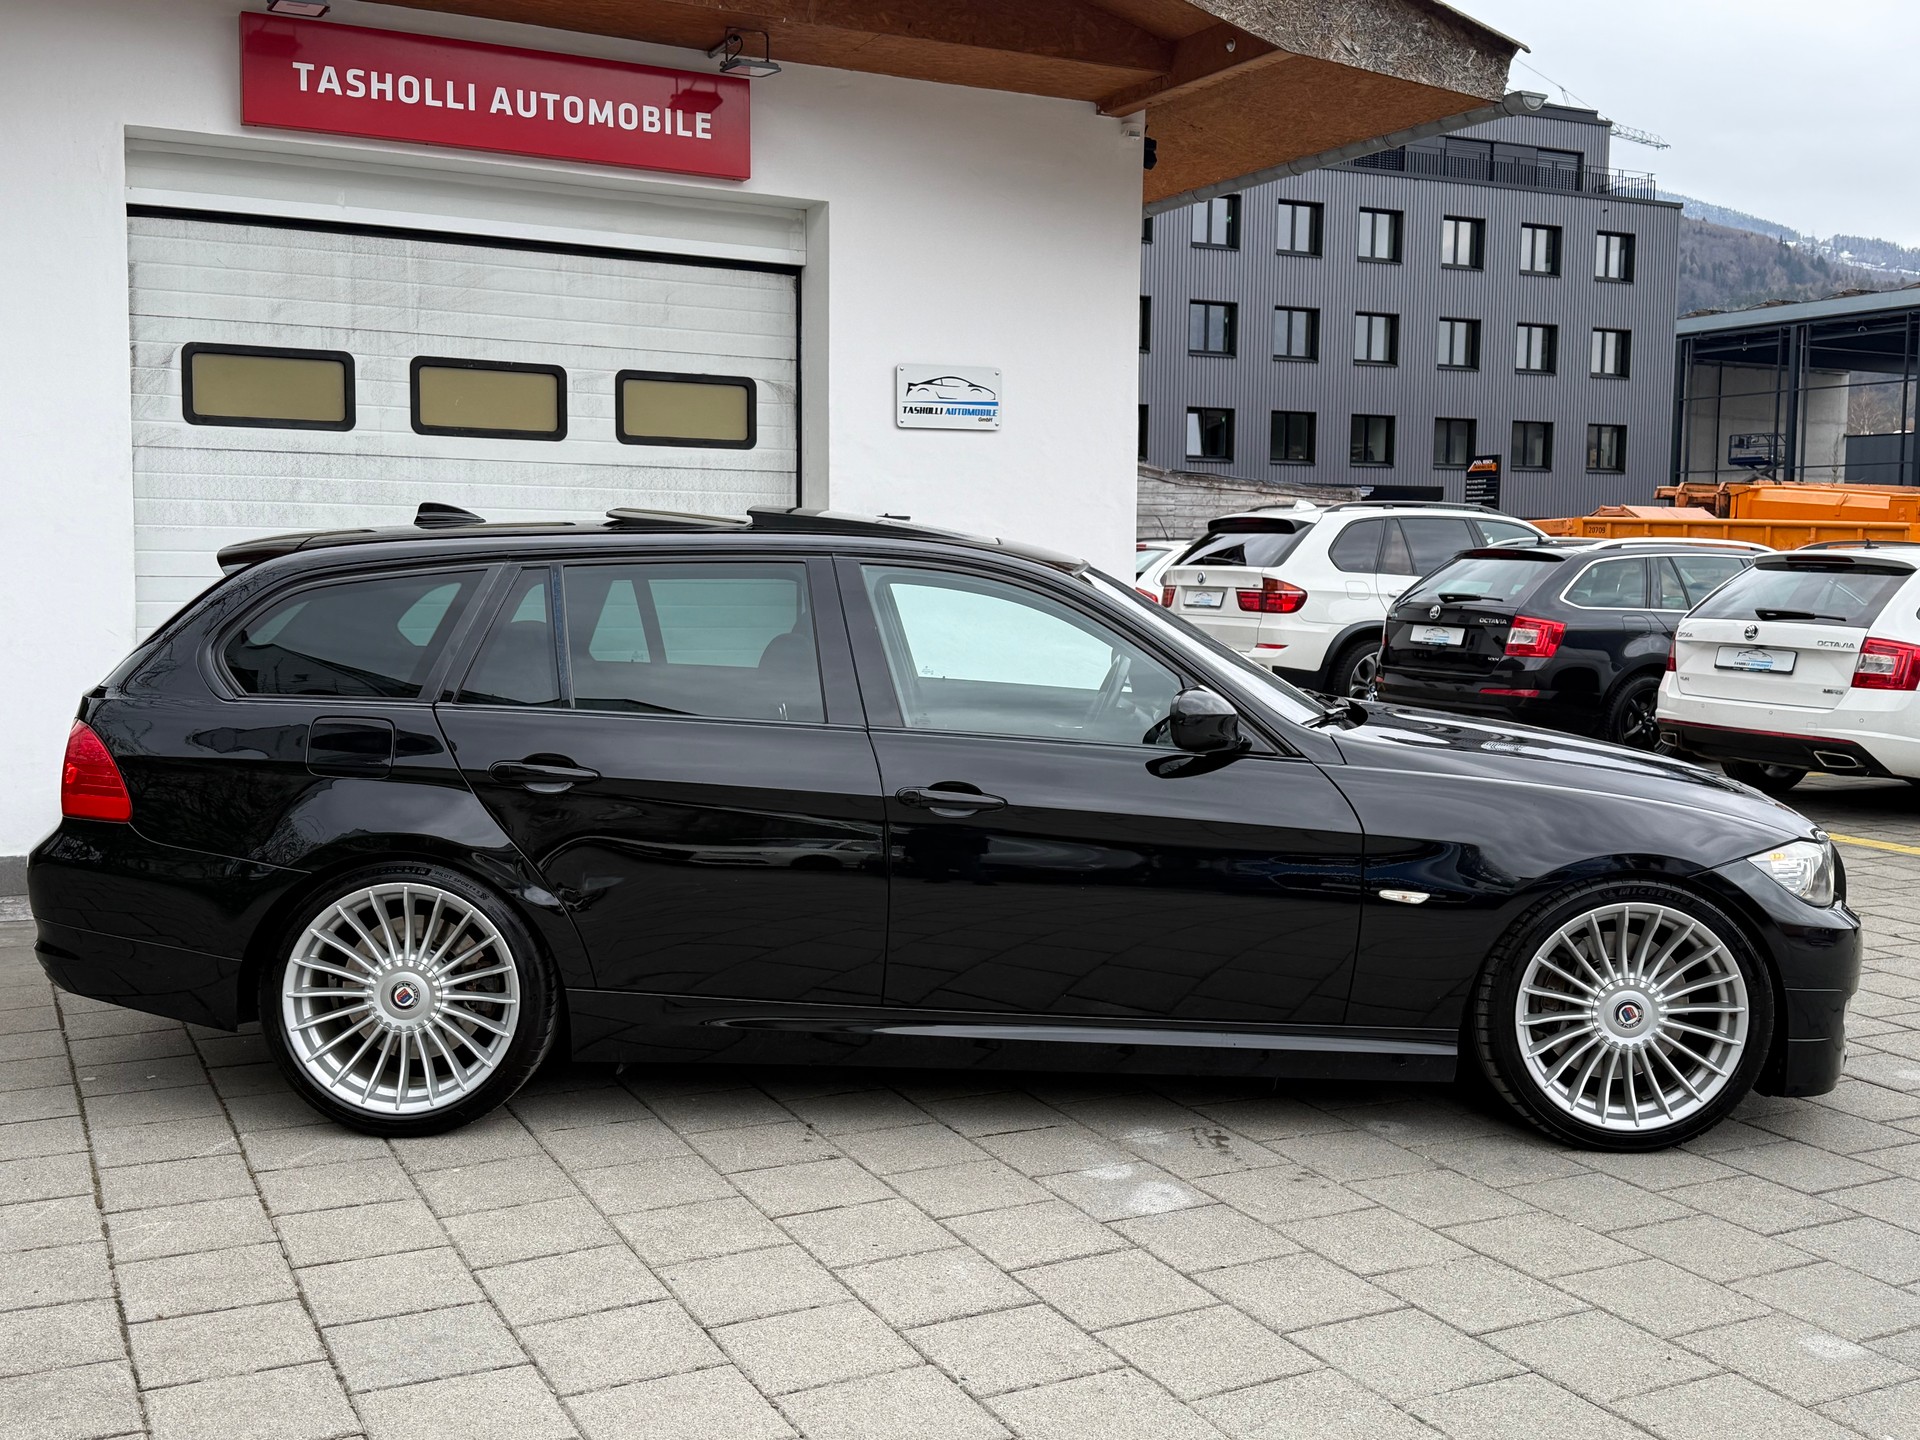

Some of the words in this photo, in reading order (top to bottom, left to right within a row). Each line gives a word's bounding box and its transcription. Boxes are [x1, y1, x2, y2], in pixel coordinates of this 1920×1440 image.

[292, 61, 476, 111] TASHOLLI
[489, 86, 712, 140] AUTOMOBILE
[902, 406, 943, 415] TASHOLLI
[945, 408, 998, 417] AUTOMOBILE
[1479, 617, 1507, 625] OCTAVIA
[1817, 640, 1855, 649] OCTAVIA
